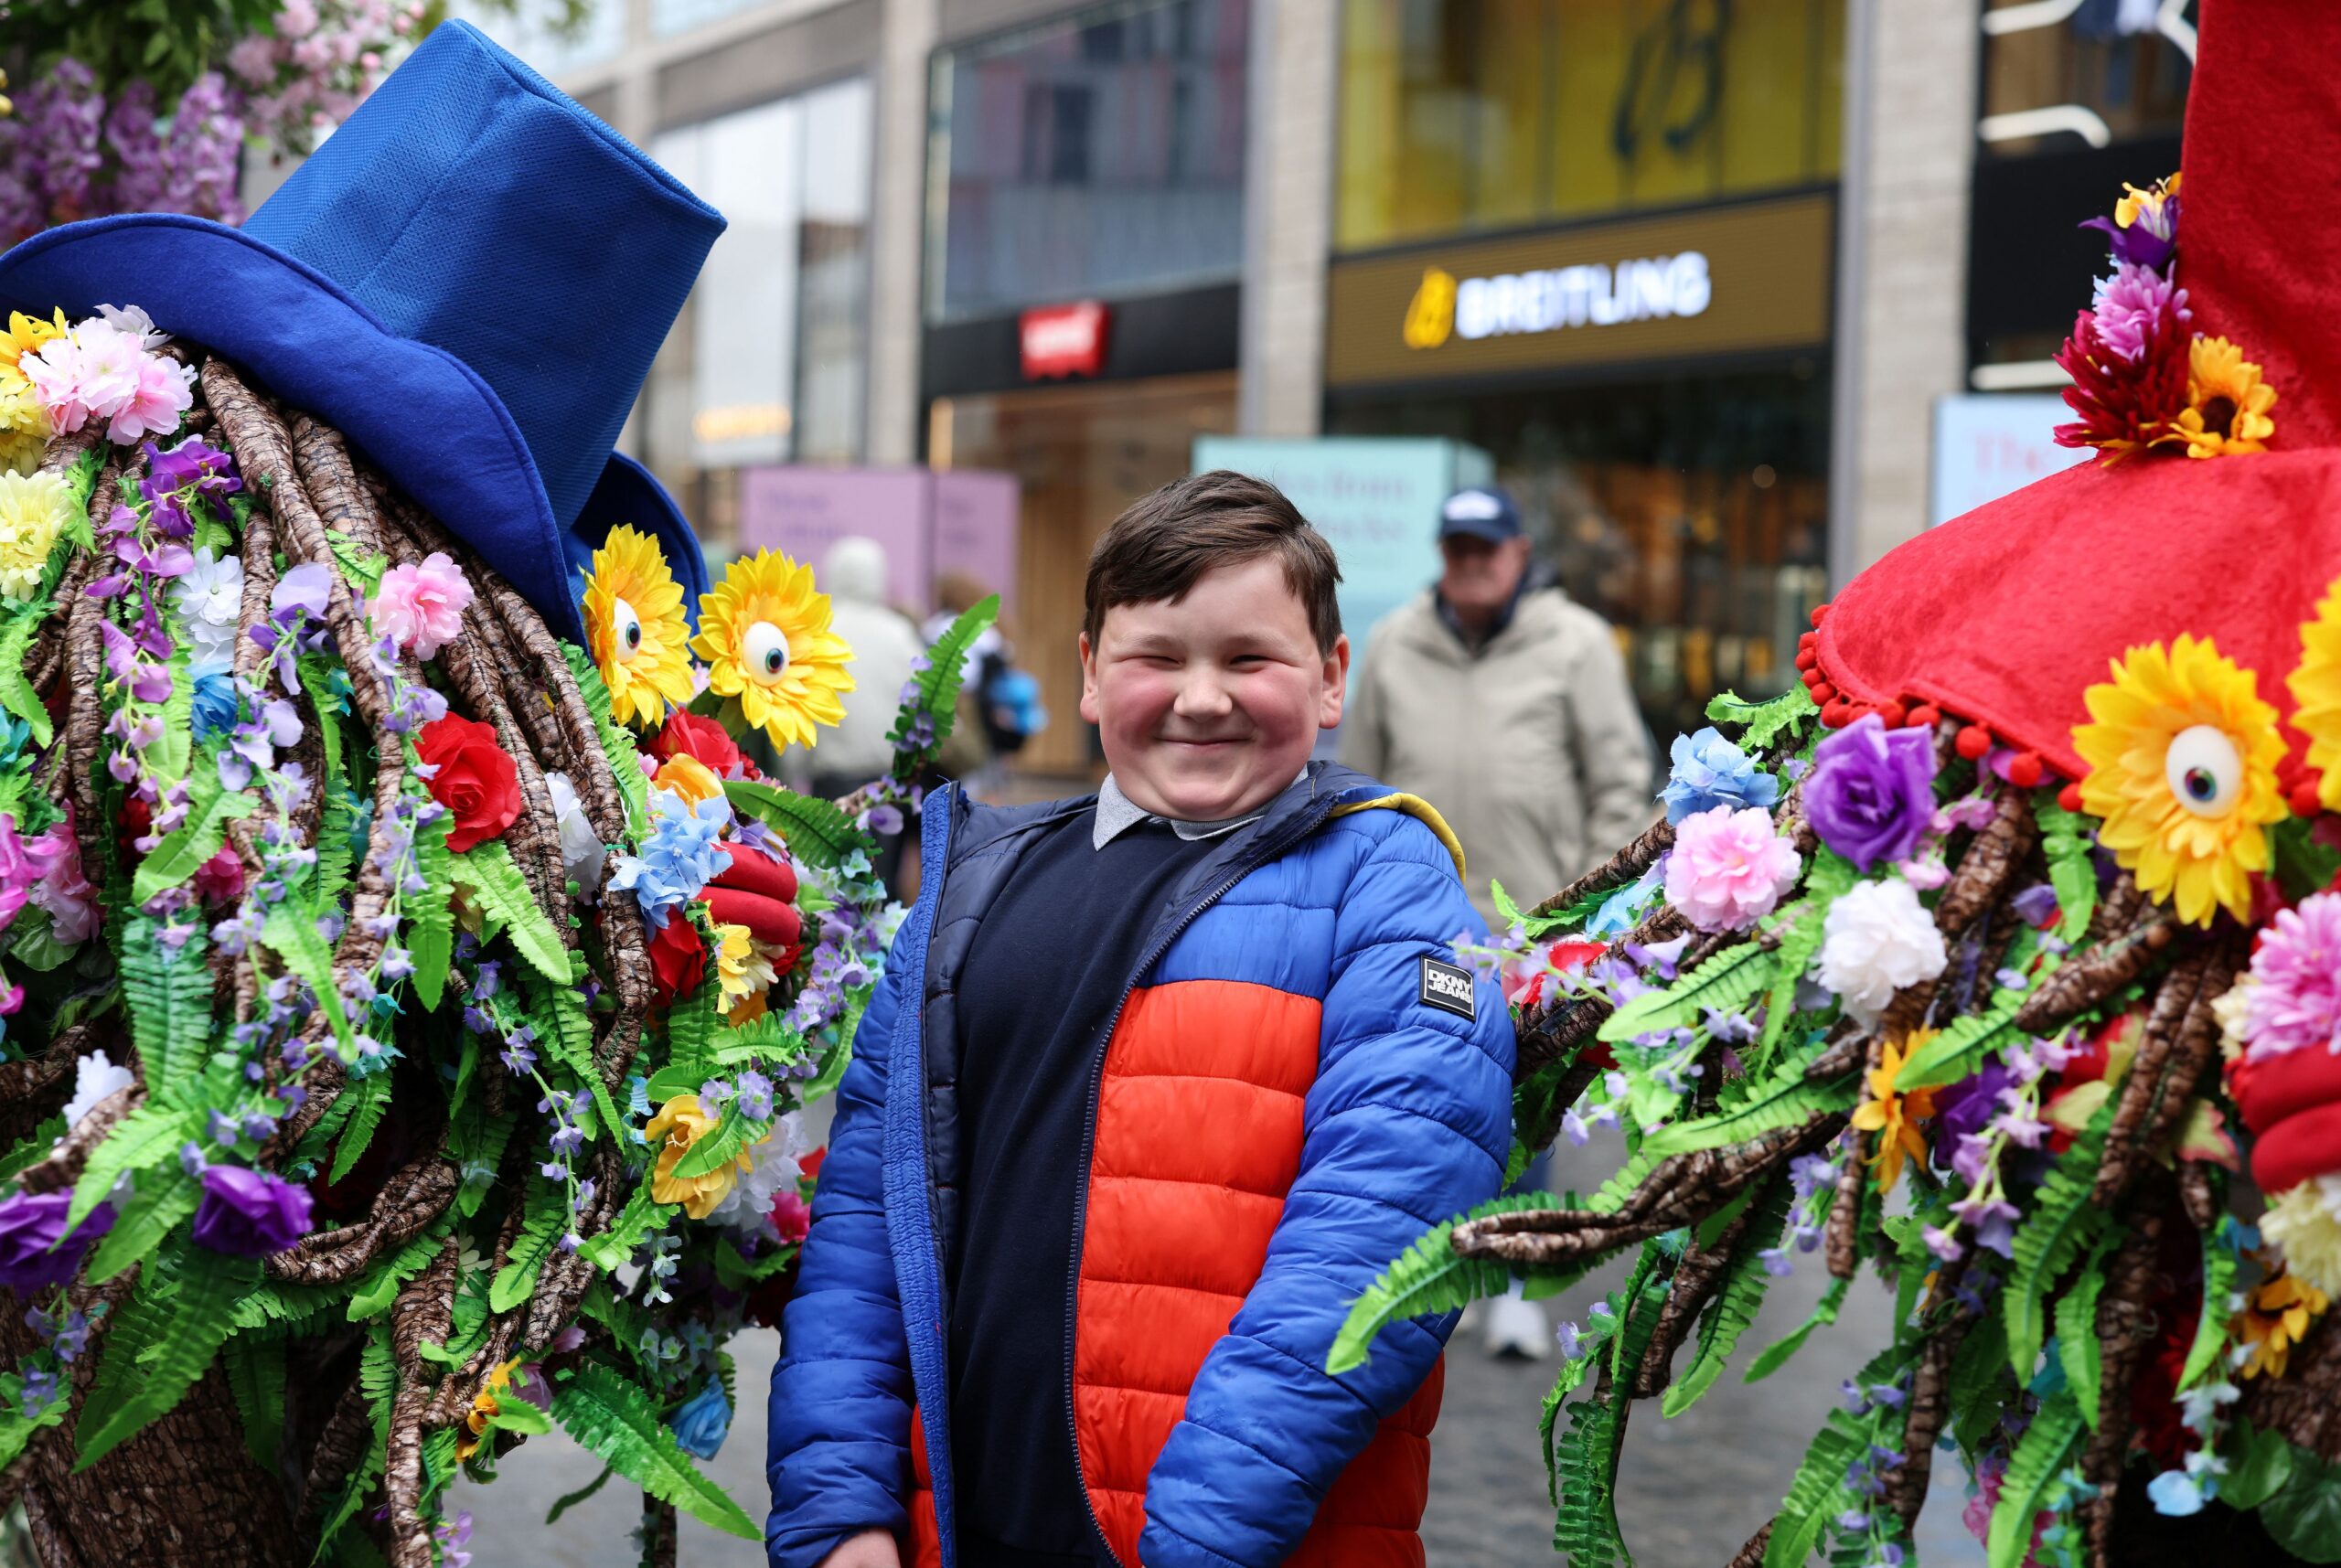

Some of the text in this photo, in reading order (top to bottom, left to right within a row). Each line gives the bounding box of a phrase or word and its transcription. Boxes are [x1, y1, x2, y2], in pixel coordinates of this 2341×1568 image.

[1456, 251, 1711, 339] BREITLING
[1428, 969, 1471, 994] DKNY
[1428, 981, 1471, 1004] JEANS
